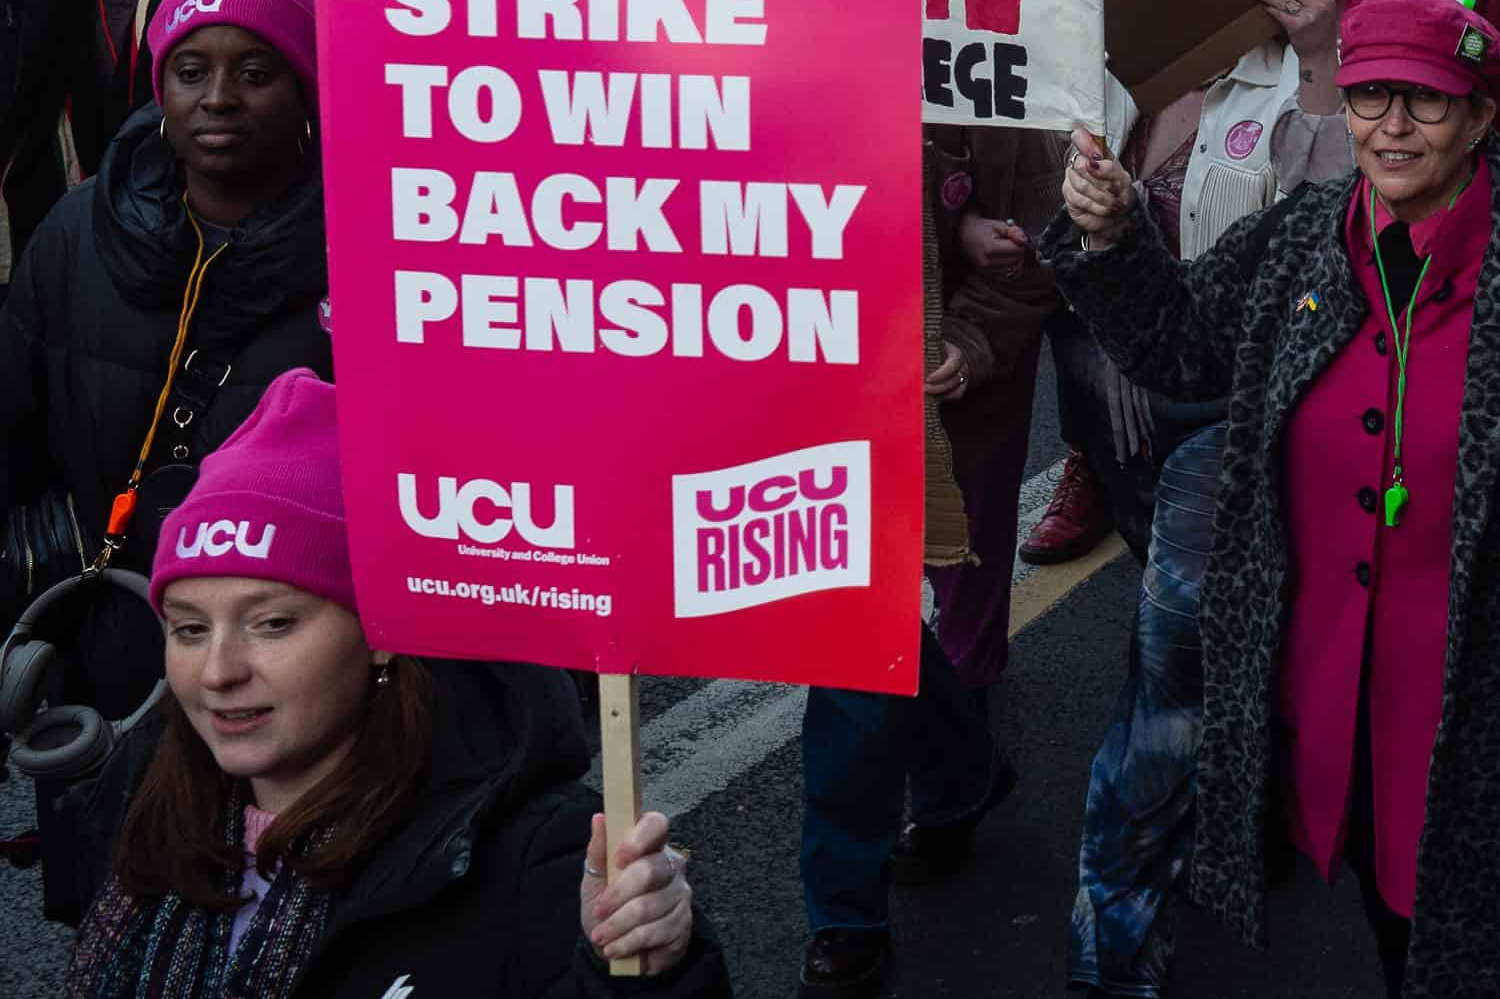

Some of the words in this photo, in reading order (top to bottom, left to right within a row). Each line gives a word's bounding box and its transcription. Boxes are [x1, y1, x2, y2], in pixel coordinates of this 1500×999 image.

[384, 63, 522, 143] TO
[538, 69, 751, 152] WIN
[391, 167, 683, 253] BACK
[700, 180, 866, 259] MY
[394, 270, 860, 365] PENSION
[397, 473, 575, 549] UCU
[695, 465, 848, 523] UCU
[175, 519, 277, 559] UCU
[457, 544, 510, 560] University
[511, 550, 532, 561] and
[533, 551, 575, 565] College
[577, 554, 610, 566] Union
[697, 502, 848, 593] RISING
[407, 576, 613, 617] ucu.org.uk/rising
